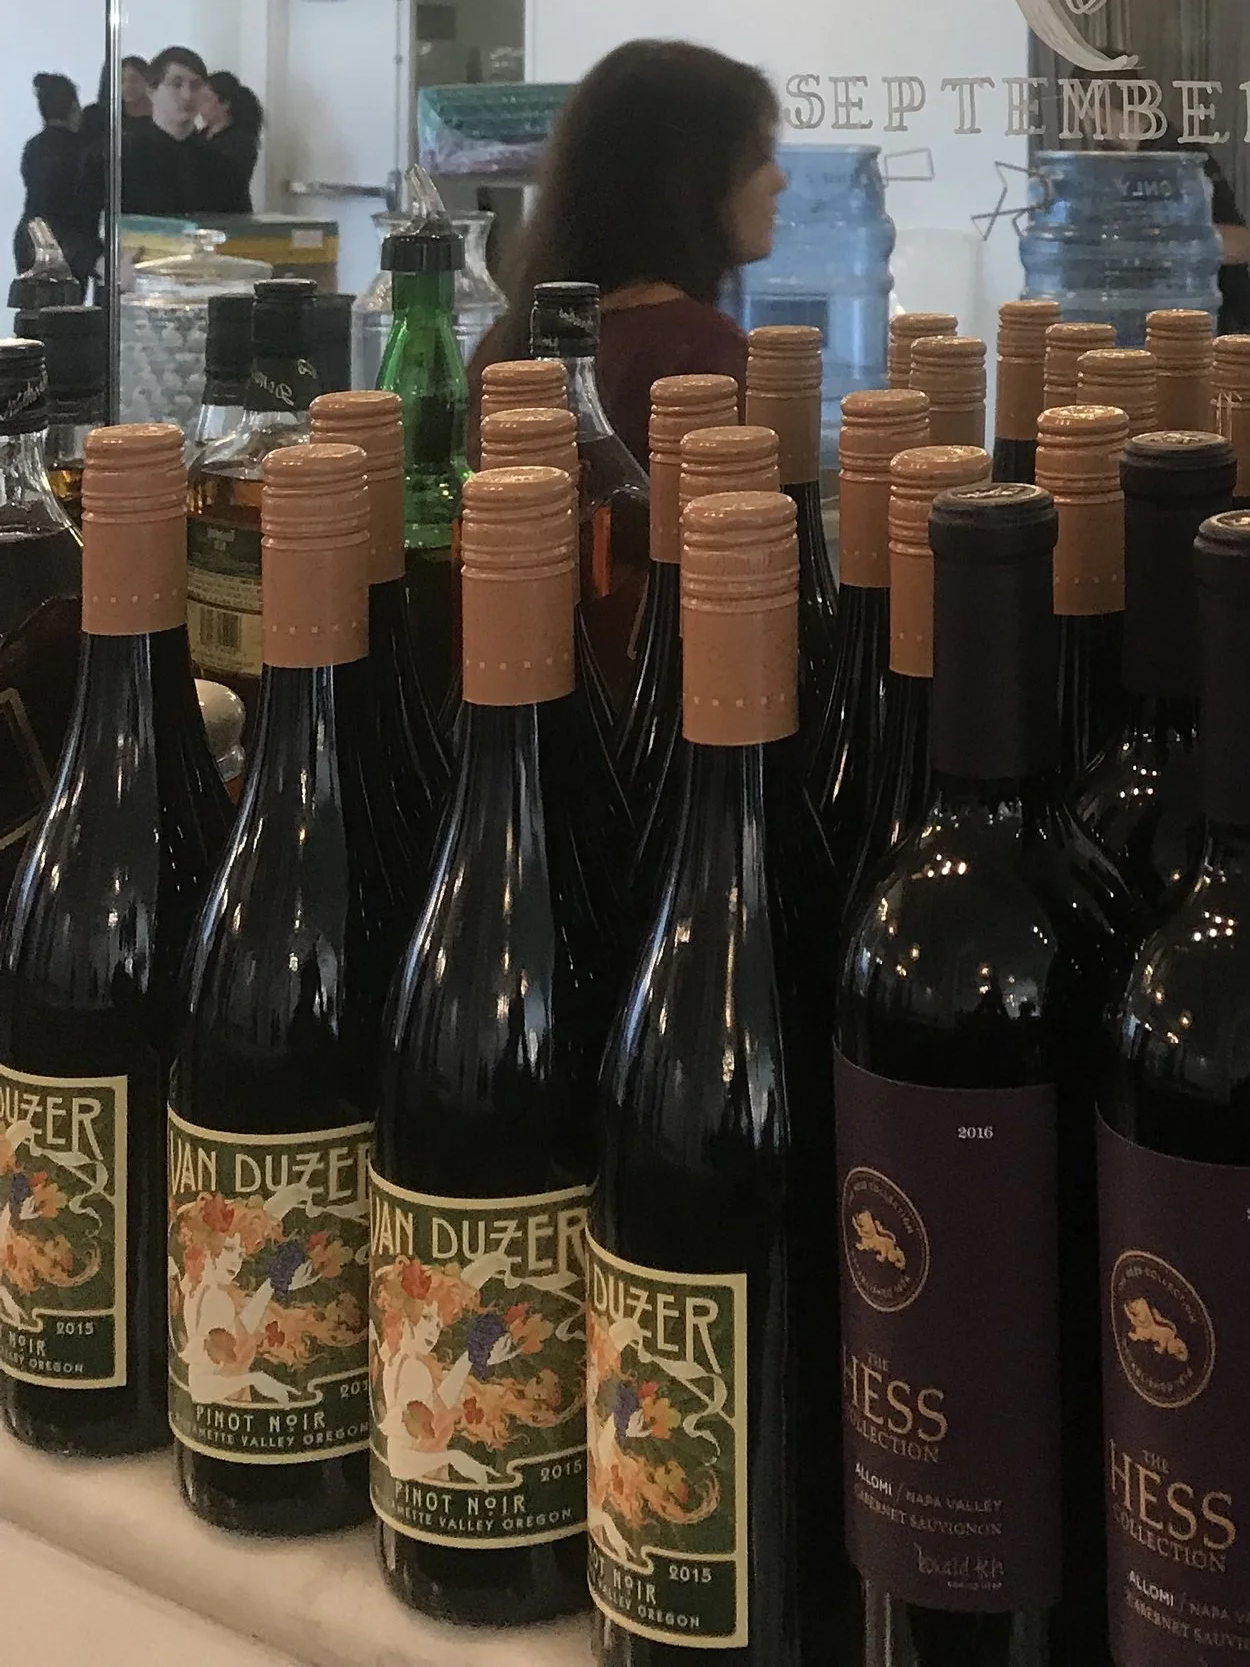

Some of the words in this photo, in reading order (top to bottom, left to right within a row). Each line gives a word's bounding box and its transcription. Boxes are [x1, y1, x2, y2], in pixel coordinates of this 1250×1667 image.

[0, 1087, 103, 1160] UZER
[958, 1126, 994, 1139] 2016
[172, 1130, 216, 1194] VAN
[372, 1196, 413, 1256] VAN
[432, 1207, 588, 1274] DUZER
[57, 1321, 94, 1335] 2015
[594, 1263, 722, 1375] DUZER
[29, 1358, 84, 1373] OREGON
[340, 1379, 369, 1399] 201
[843, 1345, 948, 1443] HESS
[196, 1405, 254, 1432] PINOT
[269, 1411, 326, 1433] NOIR
[241, 1435, 295, 1448] VALLEY
[540, 1459, 582, 1482] 2015
[1142, 1449, 1169, 1474] THE
[856, 1462, 893, 1496] ALLOMI
[395, 1480, 453, 1514] PINOT
[467, 1494, 526, 1516] NOIR
[1109, 1438, 1237, 1550] HESS
[439, 1514, 494, 1532] VALLEY
[502, 1508, 572, 1529] OREGON
[613, 1567, 656, 1605] NOIR
[669, 1565, 712, 1583] 2015
[1128, 1570, 1174, 1607] ALLOMI
[637, 1604, 701, 1629] OREGON
